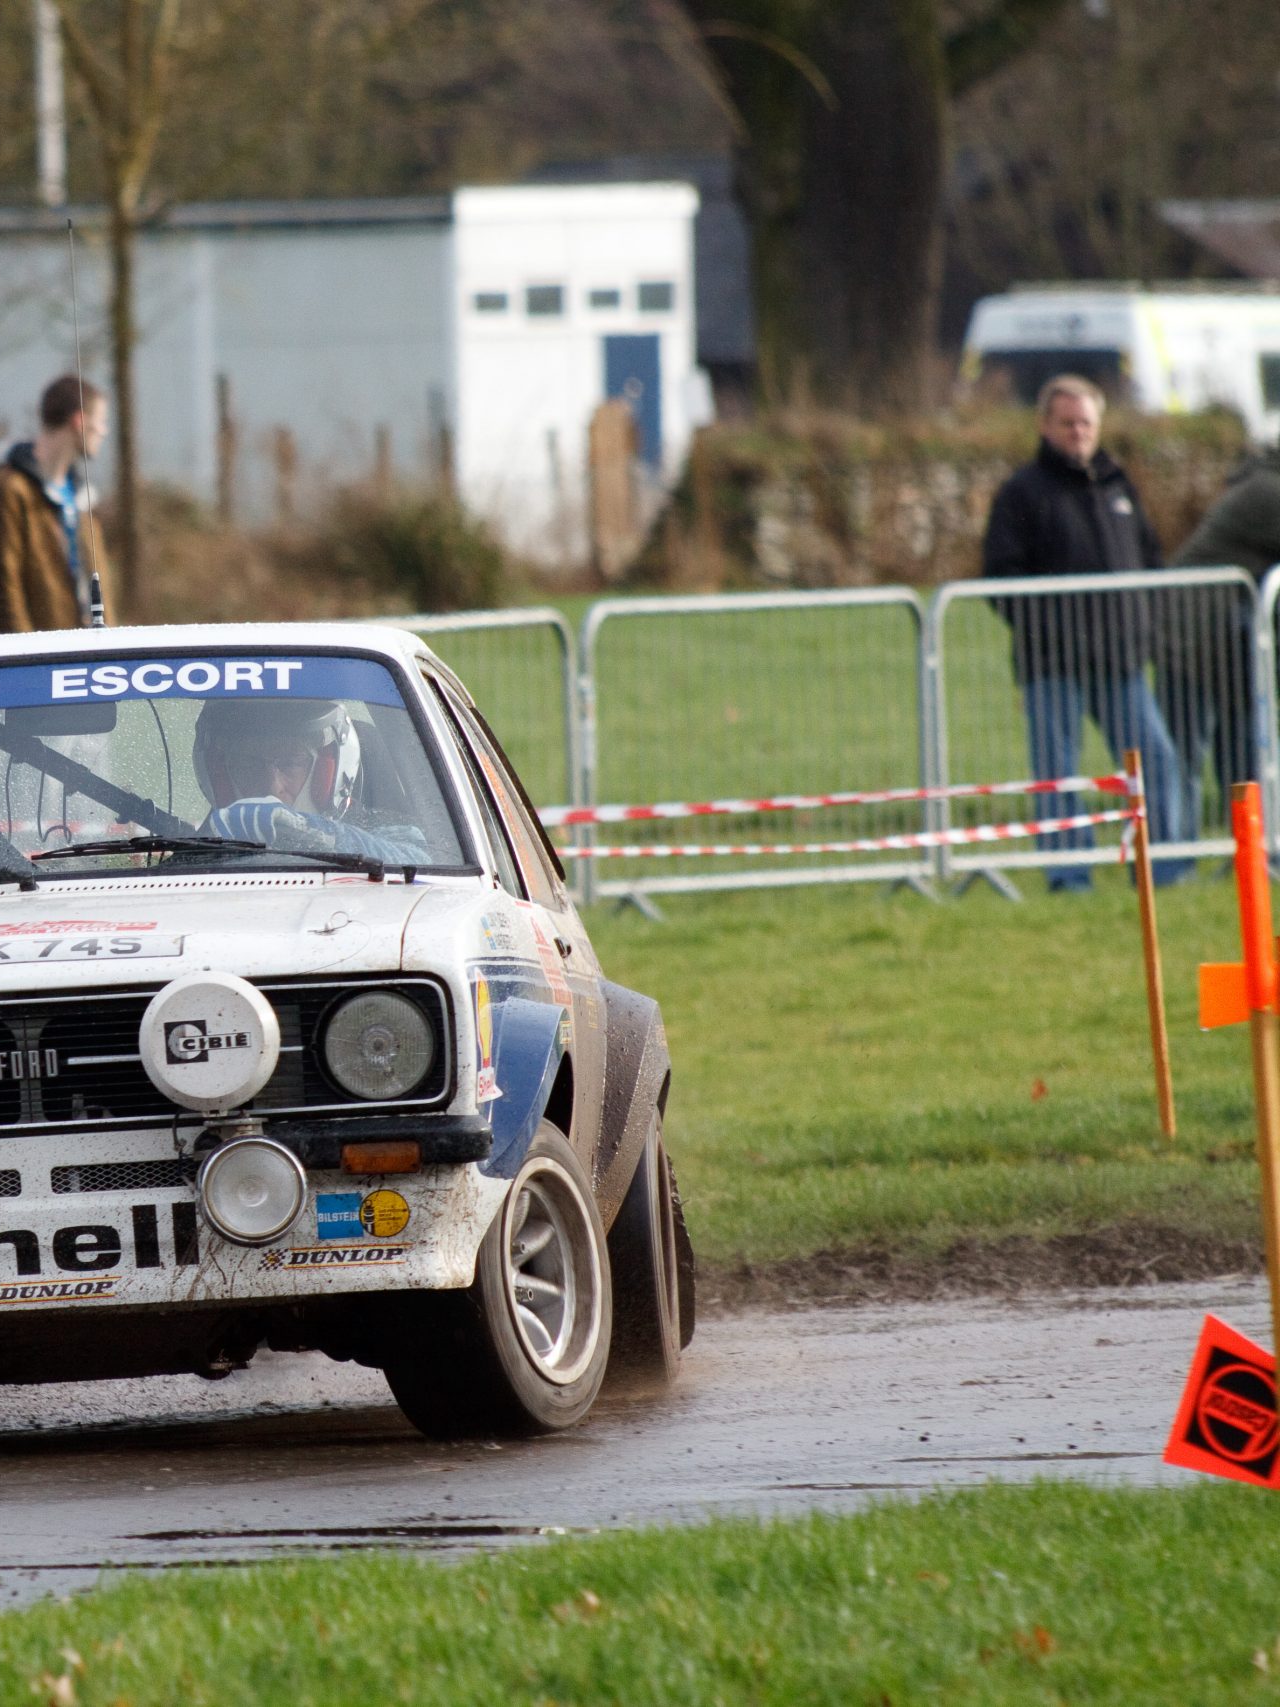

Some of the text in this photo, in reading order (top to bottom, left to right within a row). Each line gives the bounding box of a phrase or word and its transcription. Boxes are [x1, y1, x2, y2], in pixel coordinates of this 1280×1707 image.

[52, 662, 302, 698] ESCORT
[33, 937, 142, 958] 74S
[318, 1211, 360, 1223] BILSTEIN
[289, 1247, 404, 1265] DUNLOP
